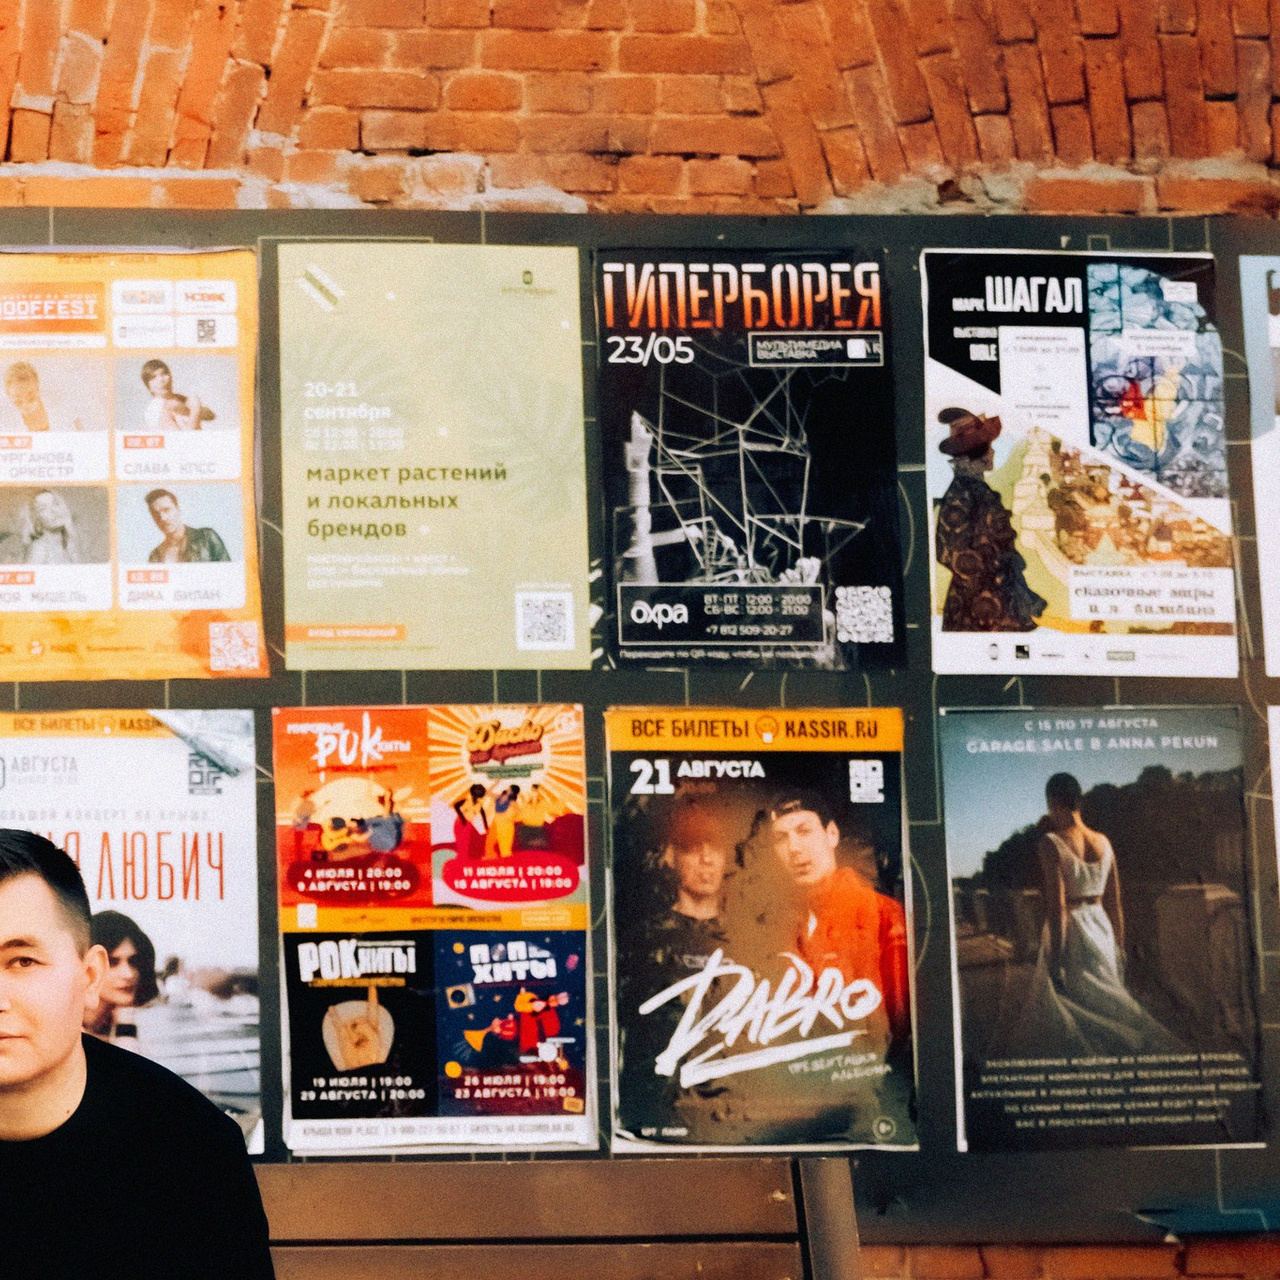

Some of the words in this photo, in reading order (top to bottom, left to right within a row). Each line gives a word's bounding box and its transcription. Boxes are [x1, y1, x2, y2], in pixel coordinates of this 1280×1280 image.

[602, 262, 882, 329] ГИПЕРБОРЕЯ
[984, 275, 1084, 314] ШАГАЛ
[607, 333, 695, 366] 23/05
[304, 381, 358, 398] 20-21
[304, 403, 392, 421] сентября
[306, 467, 391, 486] маркет
[397, 462, 508, 486] растений
[306, 496, 321, 510] и
[326, 496, 460, 510] локальных
[306, 518, 408, 542] брендов
[631, 719, 667, 739] ВСЕ
[671, 718, 750, 739] БИЛЕТЫ
[784, 718, 879, 739] KASSIR.RU
[1096, 717, 1159, 730] АВГУСТА
[966, 738, 1036, 755] GARAGE
[1040, 737, 1083, 752] SALE
[1106, 735, 1155, 749] ANNA
[1161, 734, 1219, 749] PEKUN
[10, 755, 79, 773] АВГУСТА
[629, 758, 676, 795] 21
[677, 760, 766, 779] АВГУСТА
[96, 831, 225, 901] ЛЮБИЧ
[308, 880, 367, 892] АВГУСТА
[470, 877, 528, 889] АВГУСТА
[297, 938, 361, 983] РОК
[358, 946, 417, 975] ХИТЫ
[472, 958, 557, 985] ХИТЫ
[638, 948, 882, 1077] DABRO
[319, 1090, 378, 1101] АВГУСТА
[473, 1087, 532, 1099] АВГУСТА
